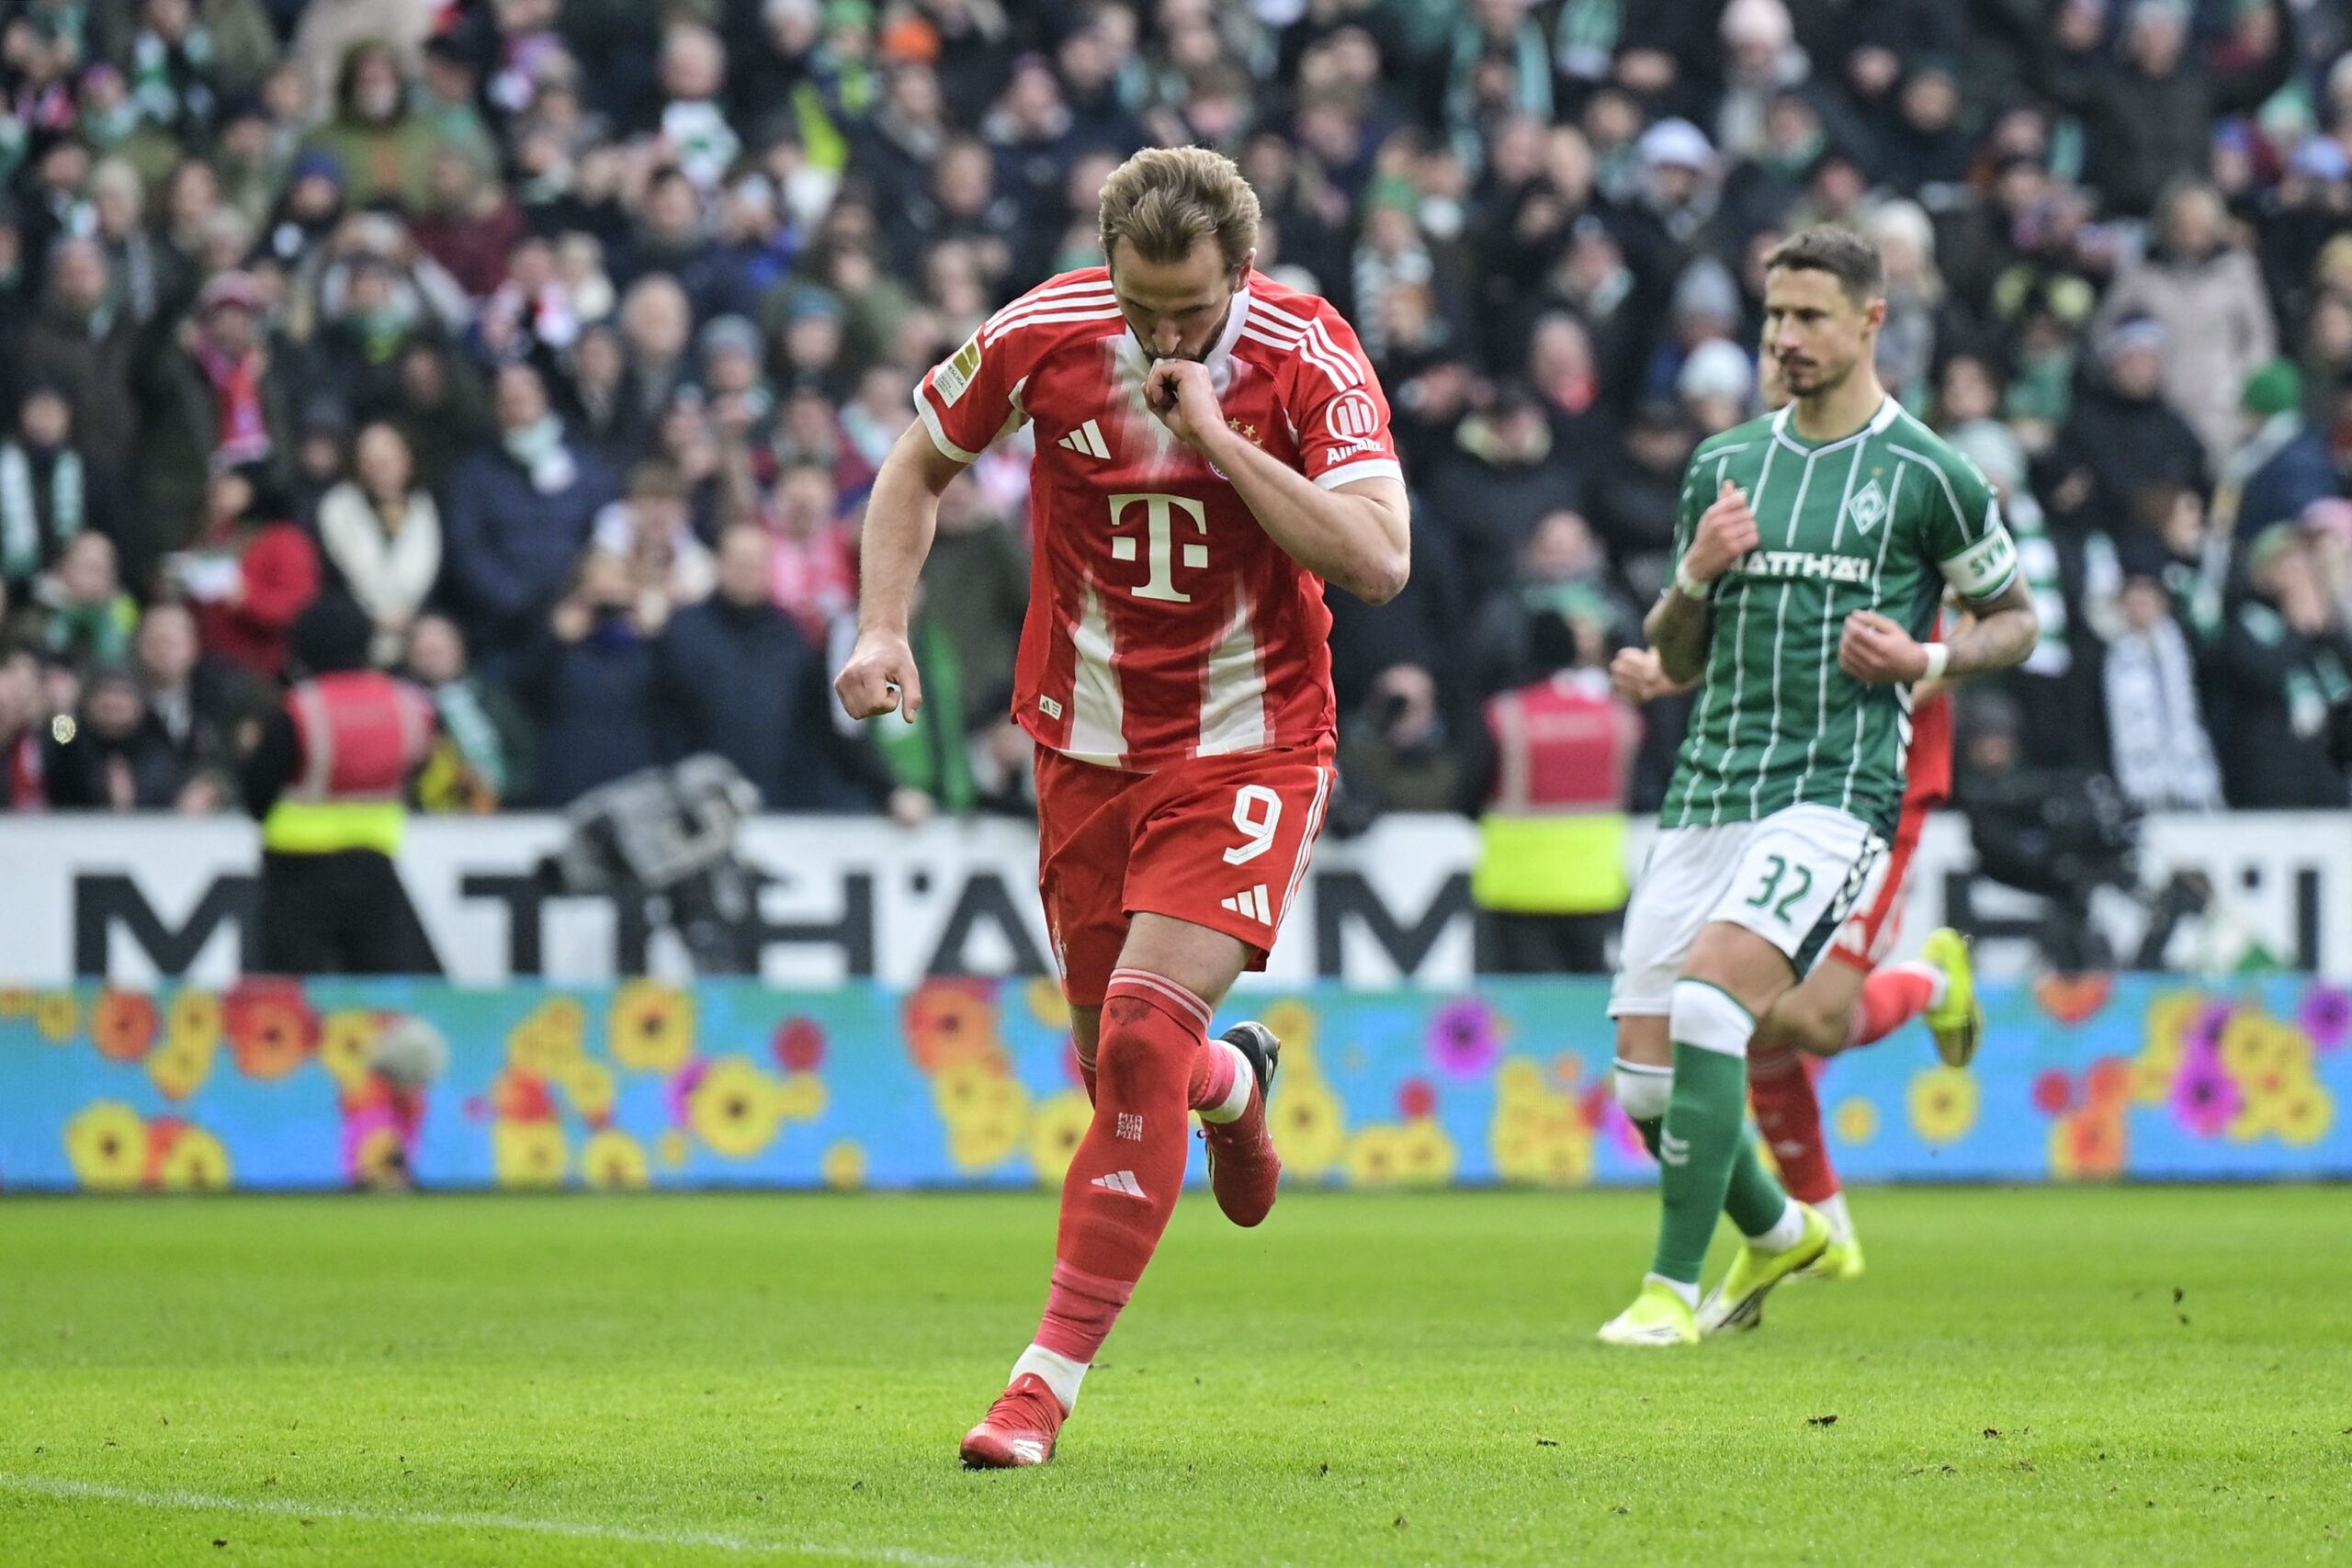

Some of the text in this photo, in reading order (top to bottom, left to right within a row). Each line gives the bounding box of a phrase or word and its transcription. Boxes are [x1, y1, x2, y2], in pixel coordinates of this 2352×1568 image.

[1107, 493, 1208, 603] T
[1222, 784, 1283, 866] 9
[1745, 854, 1812, 924] 32
[1117, 1121, 1142, 1134] SAN
[1118, 1111, 1142, 1123] MIA
